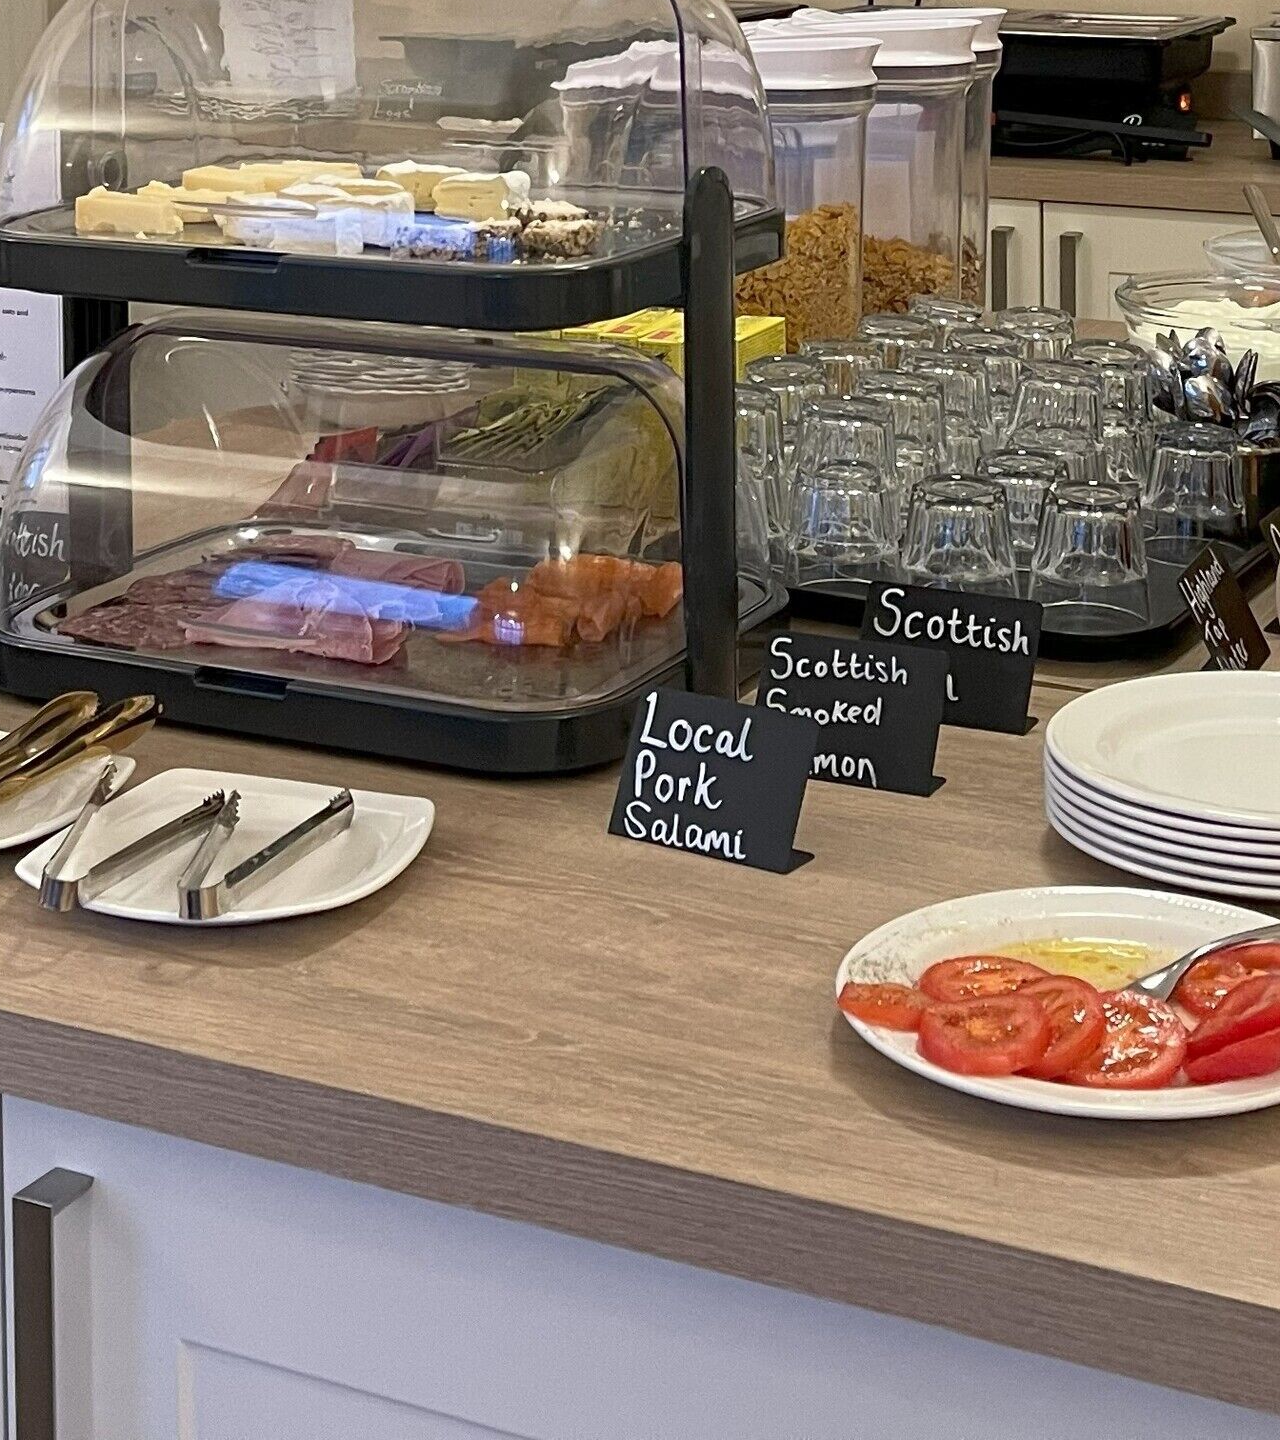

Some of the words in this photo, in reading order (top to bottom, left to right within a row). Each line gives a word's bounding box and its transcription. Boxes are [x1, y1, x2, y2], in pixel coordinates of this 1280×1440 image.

[873, 587, 1030, 656] Scottish
[1205, 617, 1230, 648] Tap
[770, 637, 908, 686] Scottish
[639, 691, 754, 762] Local
[634, 748, 723, 810] Pork
[808, 753, 877, 789] mon
[623, 800, 747, 860] Salami
